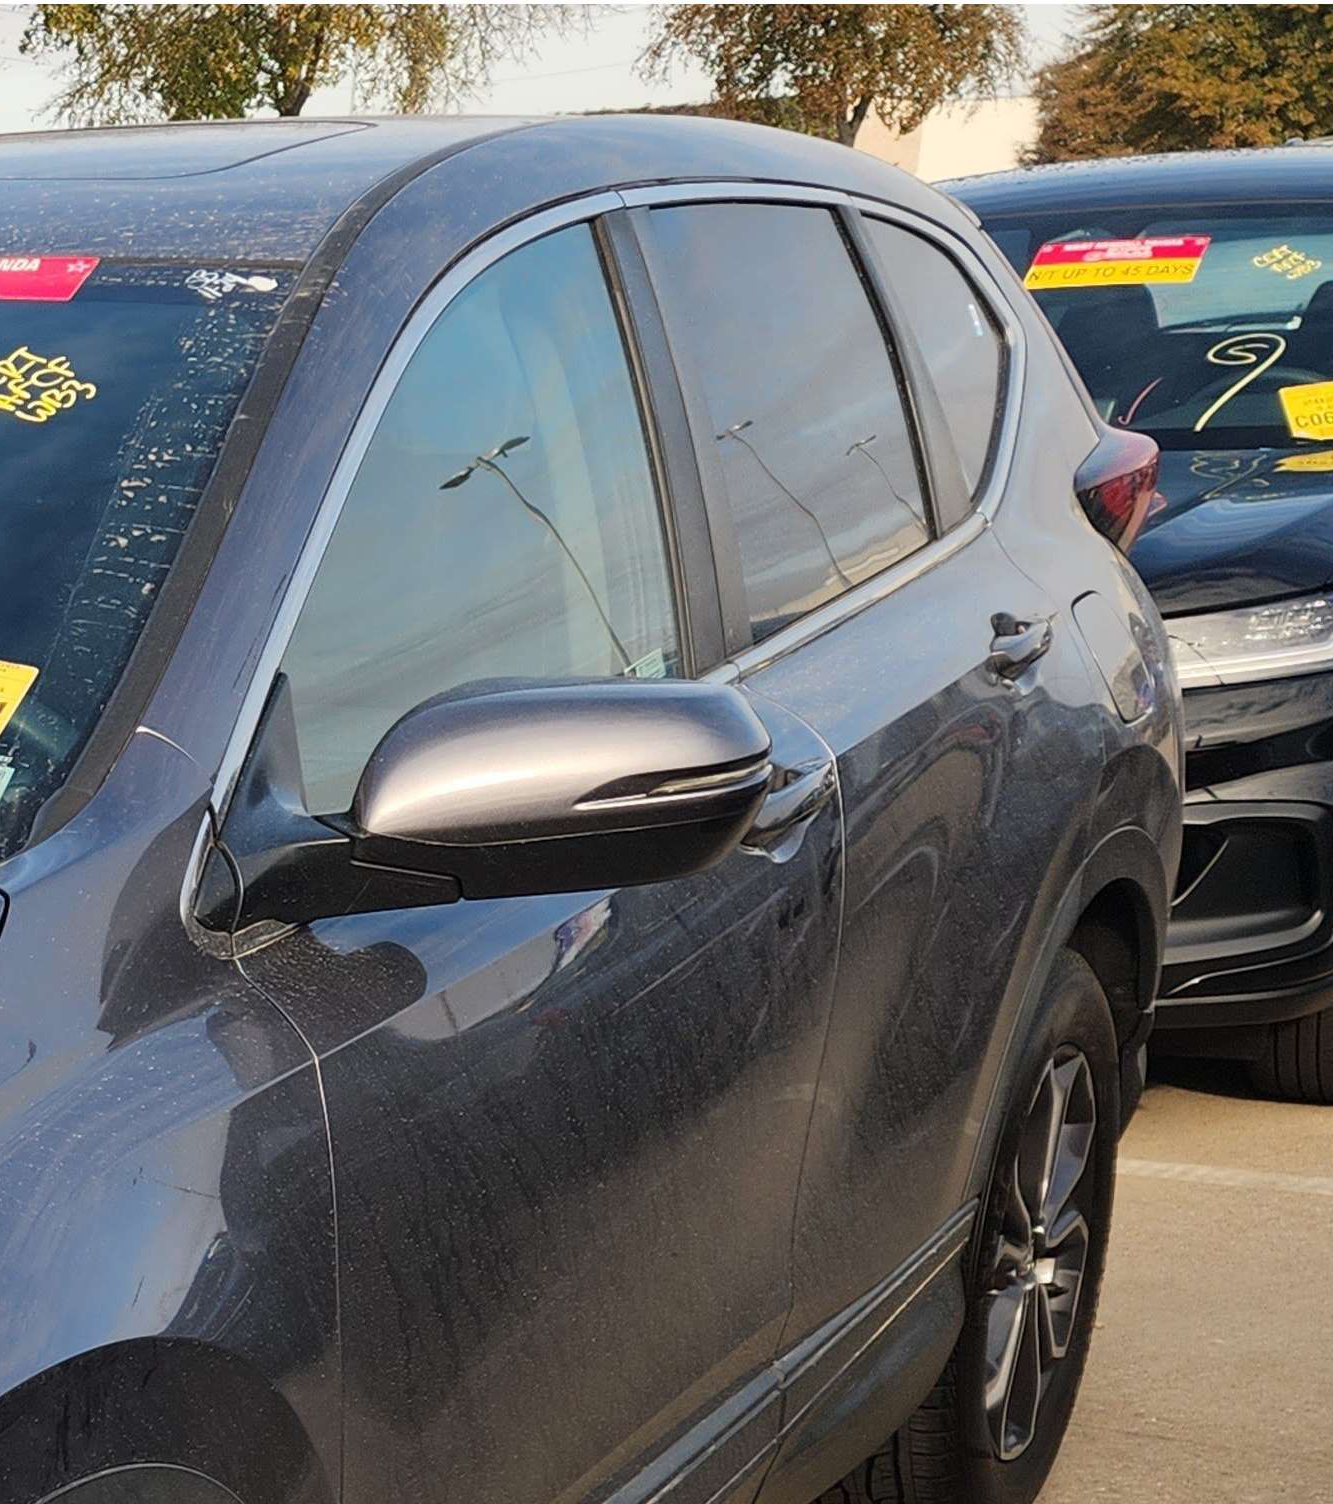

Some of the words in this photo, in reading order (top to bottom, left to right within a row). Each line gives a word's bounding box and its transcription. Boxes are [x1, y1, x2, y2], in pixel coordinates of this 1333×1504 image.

[1061, 268, 1086, 280] UP
[1092, 266, 1116, 278] TO
[1145, 263, 1195, 276] DAYS
